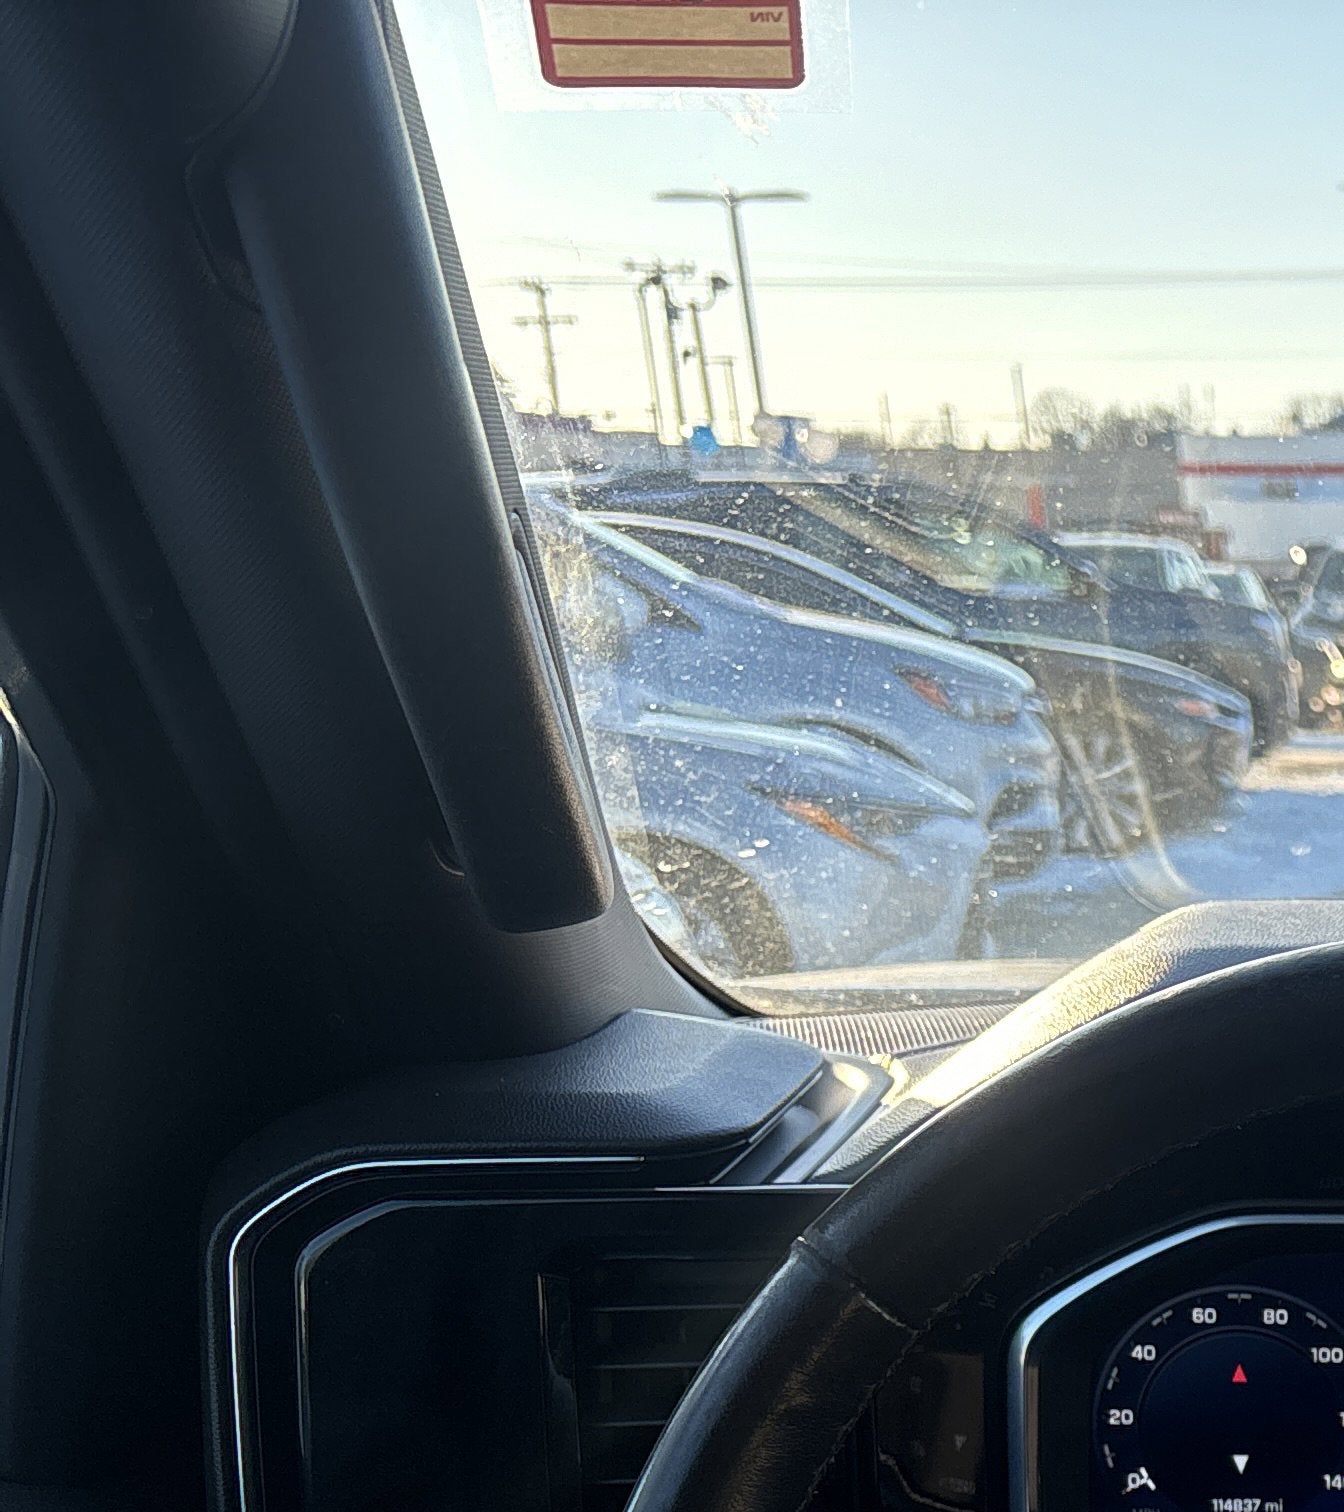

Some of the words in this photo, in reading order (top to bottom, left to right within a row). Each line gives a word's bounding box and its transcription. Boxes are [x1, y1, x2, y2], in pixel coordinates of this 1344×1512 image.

[1191, 1307, 1217, 1324] 60
[1263, 1308, 1289, 1325] 80
[1131, 1344, 1156, 1361] 40
[1310, 1346, 1344, 1364] 100
[1108, 1408, 1134, 1425] 20
[1264, 1498, 1283, 1512] mi
